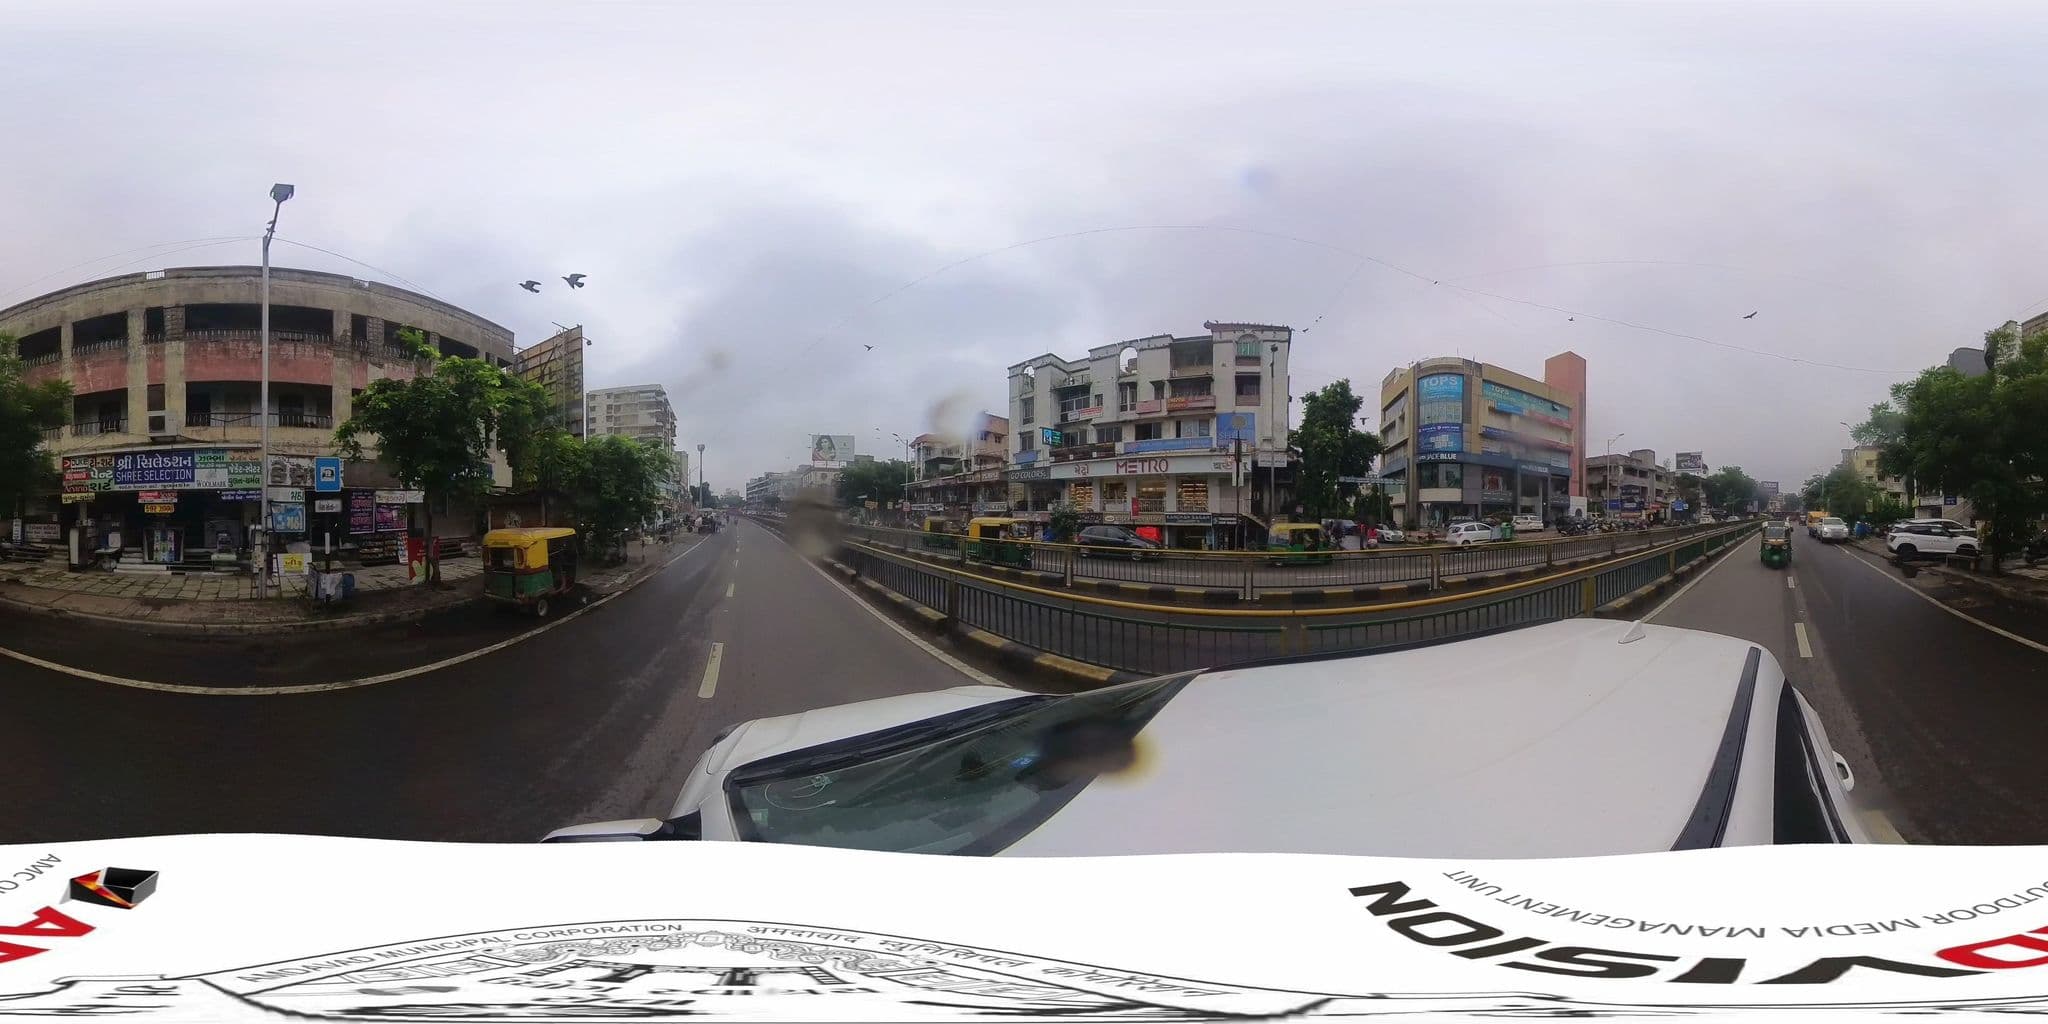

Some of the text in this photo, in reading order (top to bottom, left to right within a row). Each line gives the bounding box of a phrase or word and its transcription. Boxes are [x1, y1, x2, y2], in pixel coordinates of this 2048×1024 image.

[1423, 376, 1457, 387] TOPS
[117, 455, 132, 470] શ્રી
[1116, 458, 1169, 474] METRO
[116, 469, 192, 482] SHREE SELECTION
